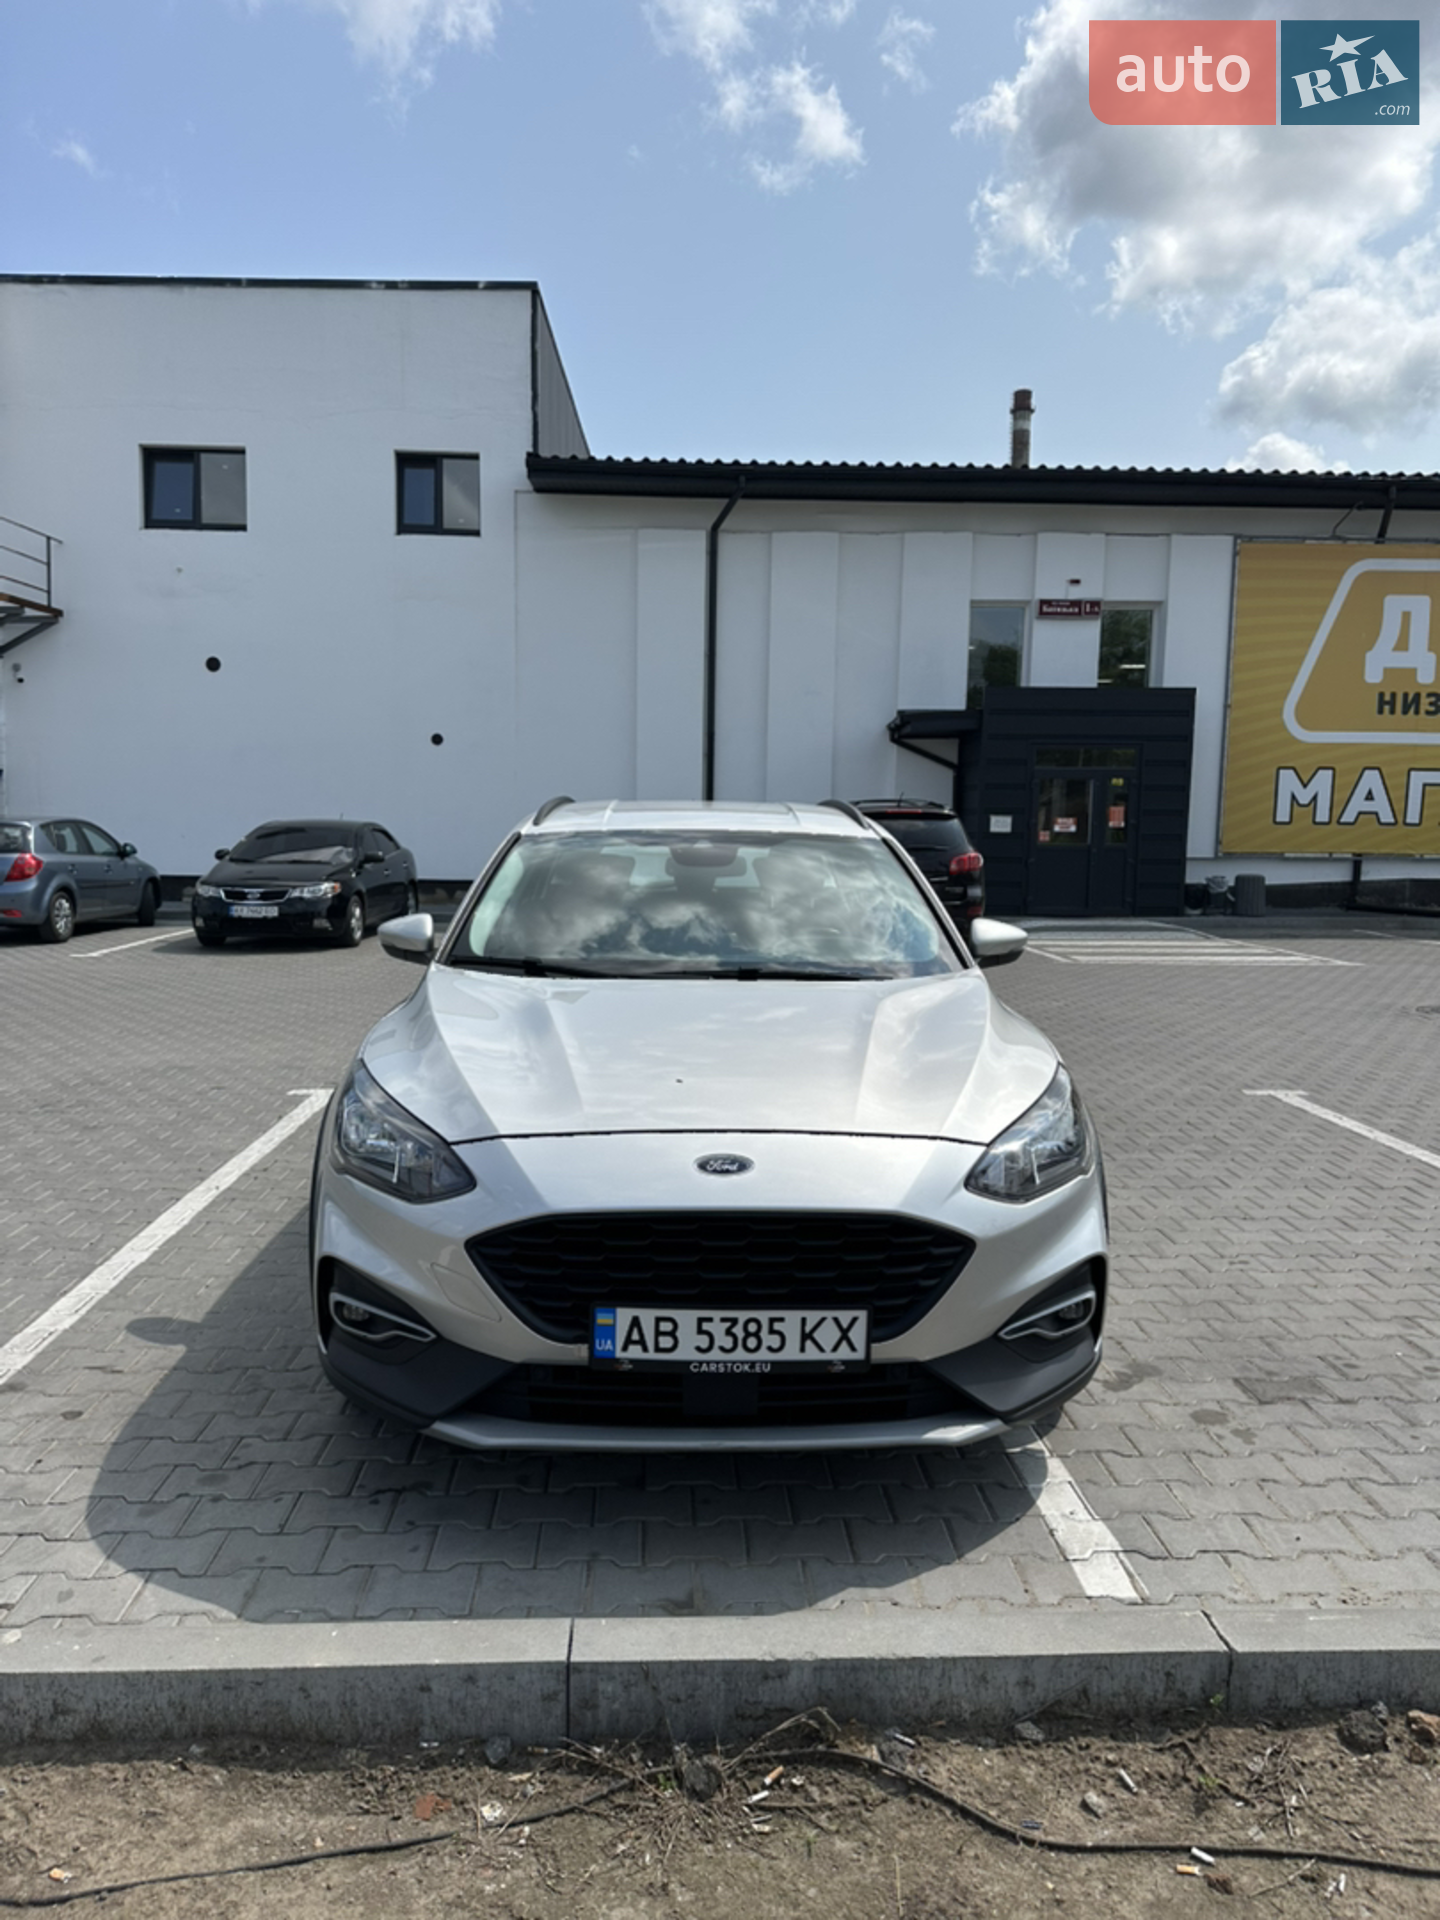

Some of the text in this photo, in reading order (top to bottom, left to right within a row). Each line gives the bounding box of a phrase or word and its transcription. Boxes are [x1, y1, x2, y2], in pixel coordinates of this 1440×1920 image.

[620, 1315, 860, 1354] AB 5385 KX
[595, 1339, 614, 1351] UA
[689, 1362, 771, 1373] CARSTOK.EU
